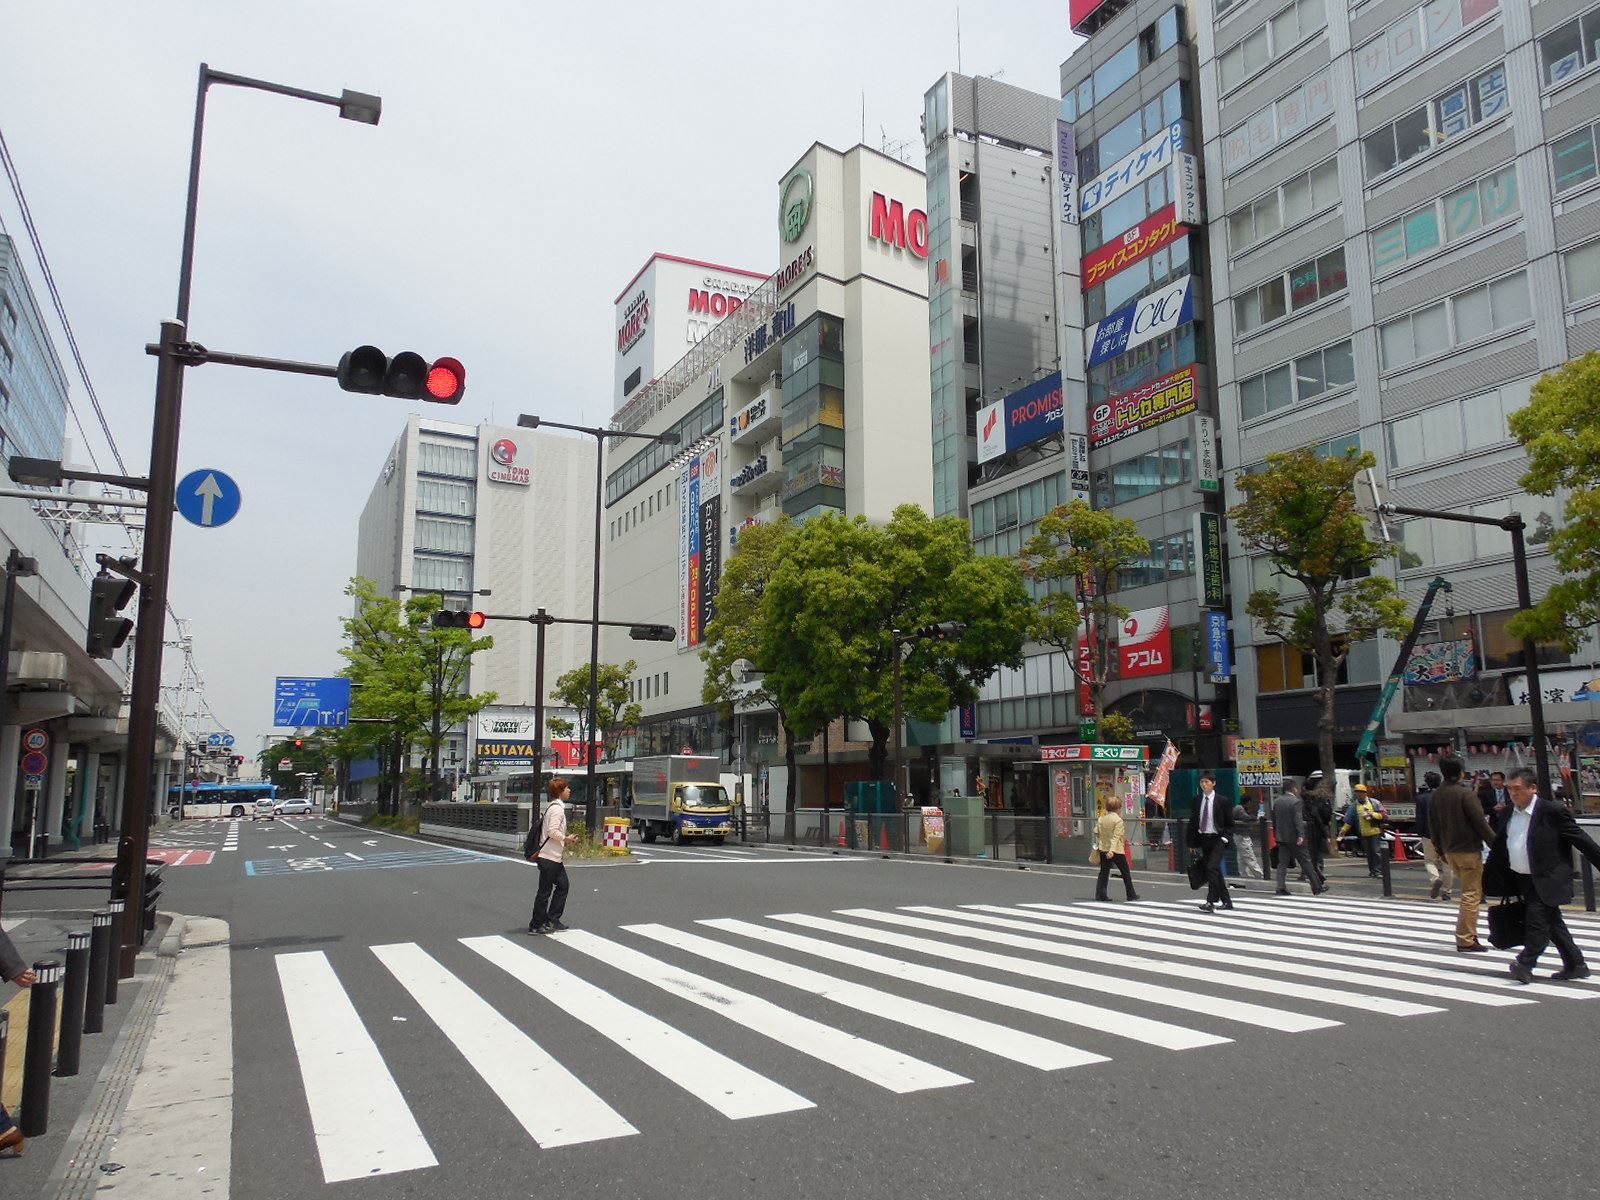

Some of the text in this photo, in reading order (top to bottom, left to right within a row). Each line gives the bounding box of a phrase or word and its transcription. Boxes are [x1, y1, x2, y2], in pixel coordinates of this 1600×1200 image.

[1088, 219, 1176, 284] プライスコンタクト
[776, 246, 813, 292] MORE'S
[617, 298, 649, 352] MORE'S
[744, 301, 796, 365] 洋服の青山
[1116, 380, 1193, 428] トレカ専門店
[1095, 407, 1109, 421] 6F
[490, 471, 530, 483] CINEMAS
[507, 466, 529, 475] TOHO
[1126, 648, 1164, 669] アコム
[30, 735, 43, 746] 40
[477, 743, 534, 756] TSUTAYA
[1048, 748, 1066, 759] 宝くじ
[1094, 747, 1119, 758] 宝くじ
